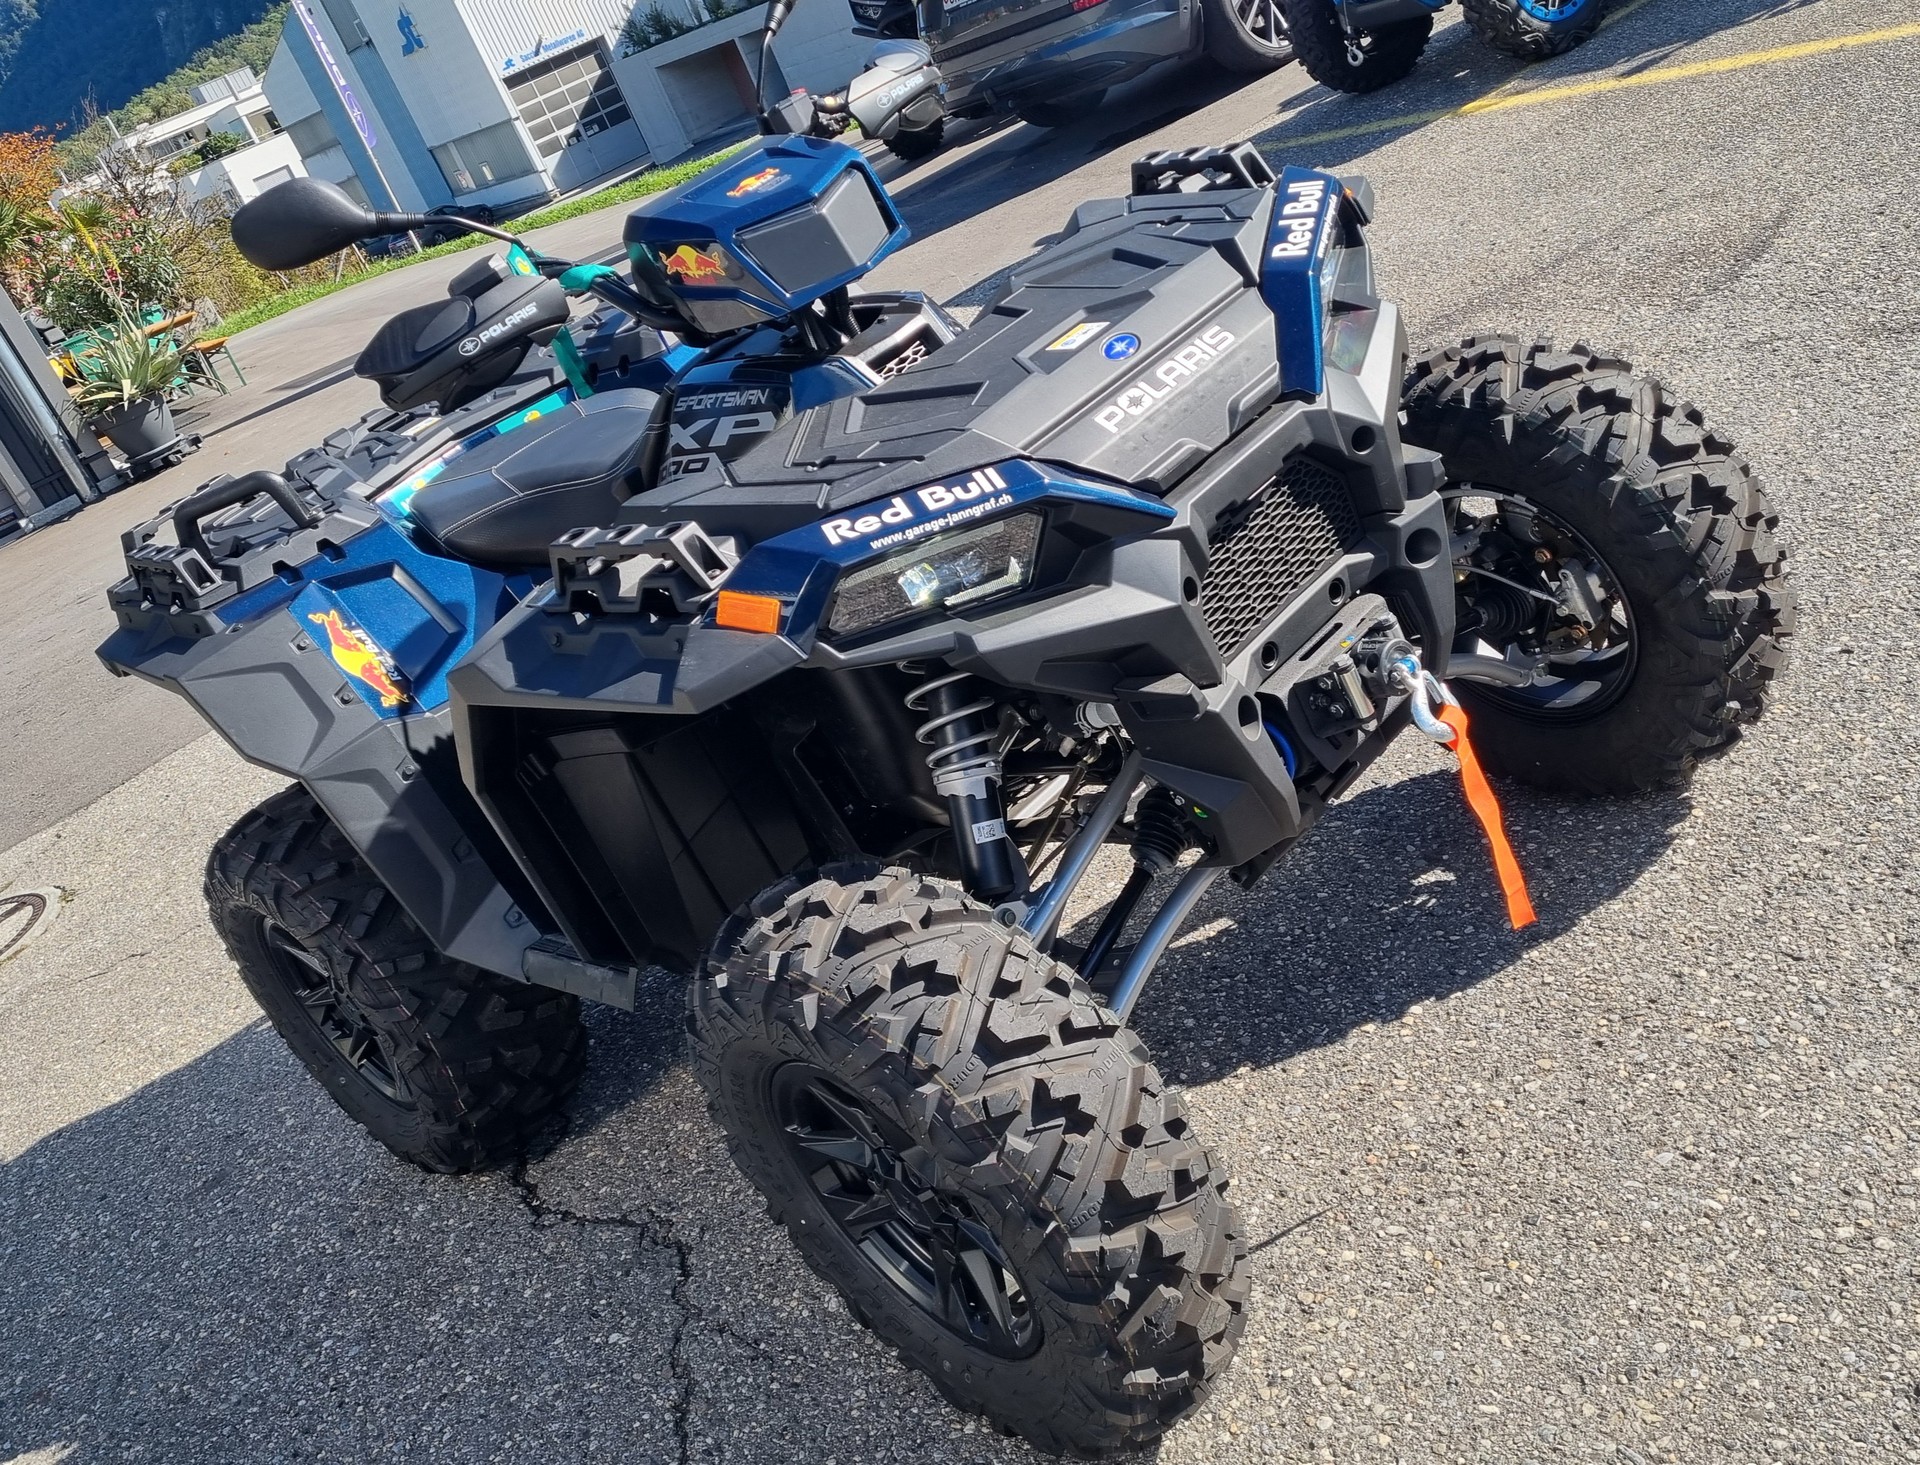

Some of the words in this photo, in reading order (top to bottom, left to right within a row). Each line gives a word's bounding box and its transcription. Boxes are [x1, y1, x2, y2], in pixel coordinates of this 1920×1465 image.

[890, 73, 924, 99] POLARIS
[1282, 180, 1325, 215] Bull
[1271, 217, 1316, 257] Red
[479, 304, 537, 343] POLARIS
[1094, 325, 1235, 433] POLARIS
[674, 388, 769, 412] SPORTSMAN
[665, 411, 777, 450] XP
[820, 497, 914, 545] Red
[917, 467, 1007, 511] Bull
[870, 493, 1013, 550] www.garage-janngraf.ch
[351, 629, 380, 653] Bull
